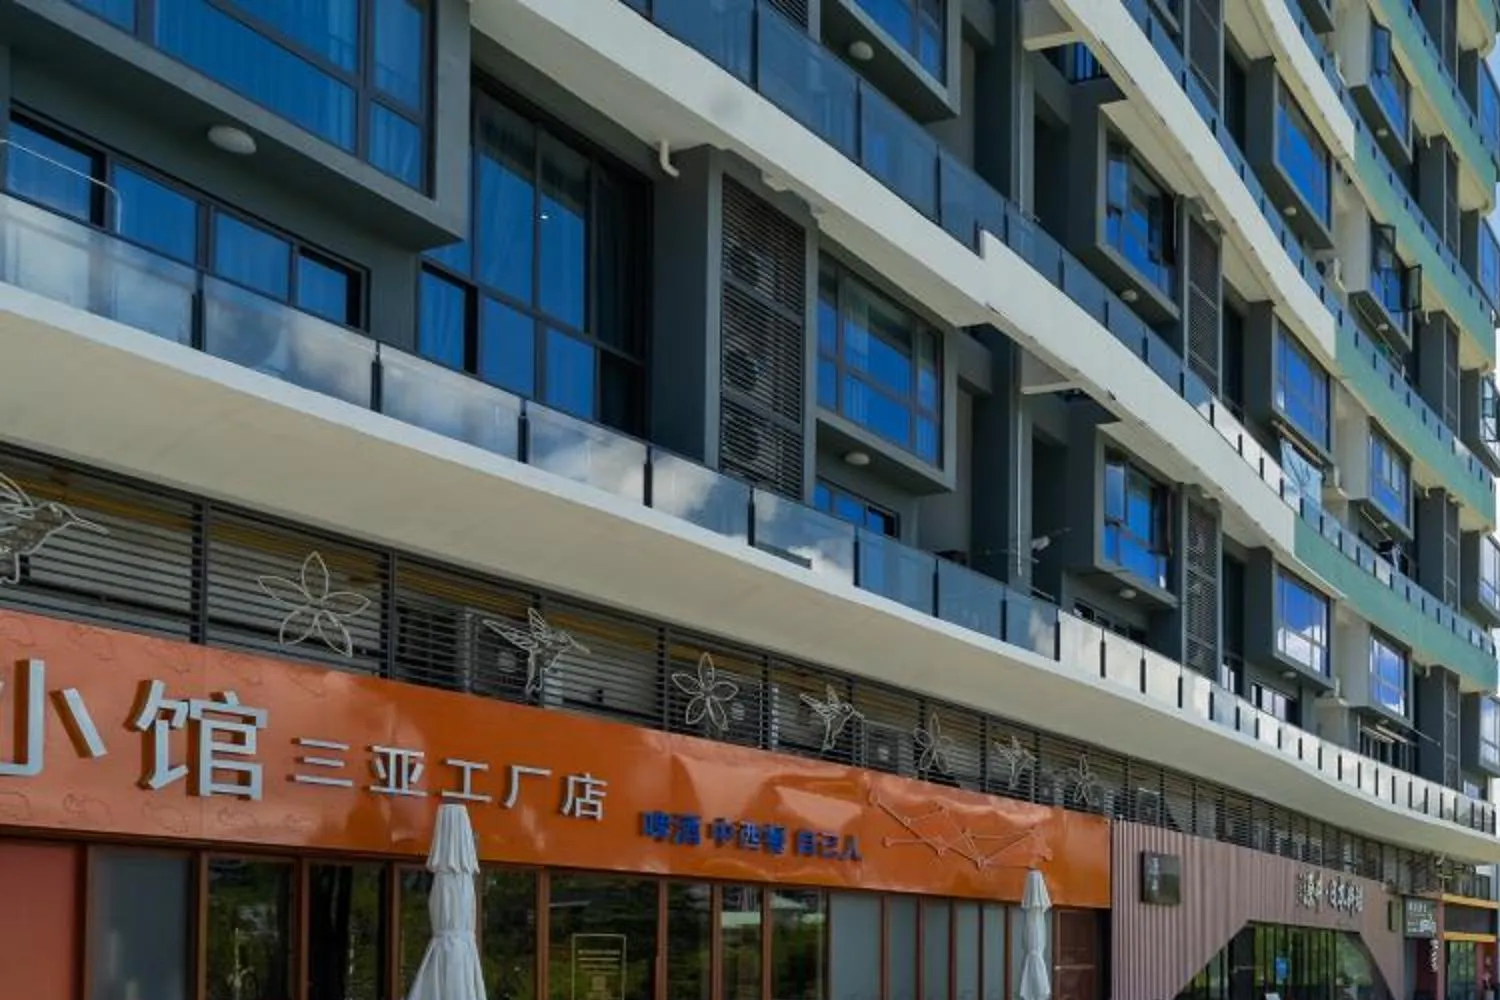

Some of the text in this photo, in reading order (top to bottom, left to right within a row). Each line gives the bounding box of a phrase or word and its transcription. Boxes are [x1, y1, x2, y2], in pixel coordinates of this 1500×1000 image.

[0, 658, 608, 821] 小馆 三亚工厂店
